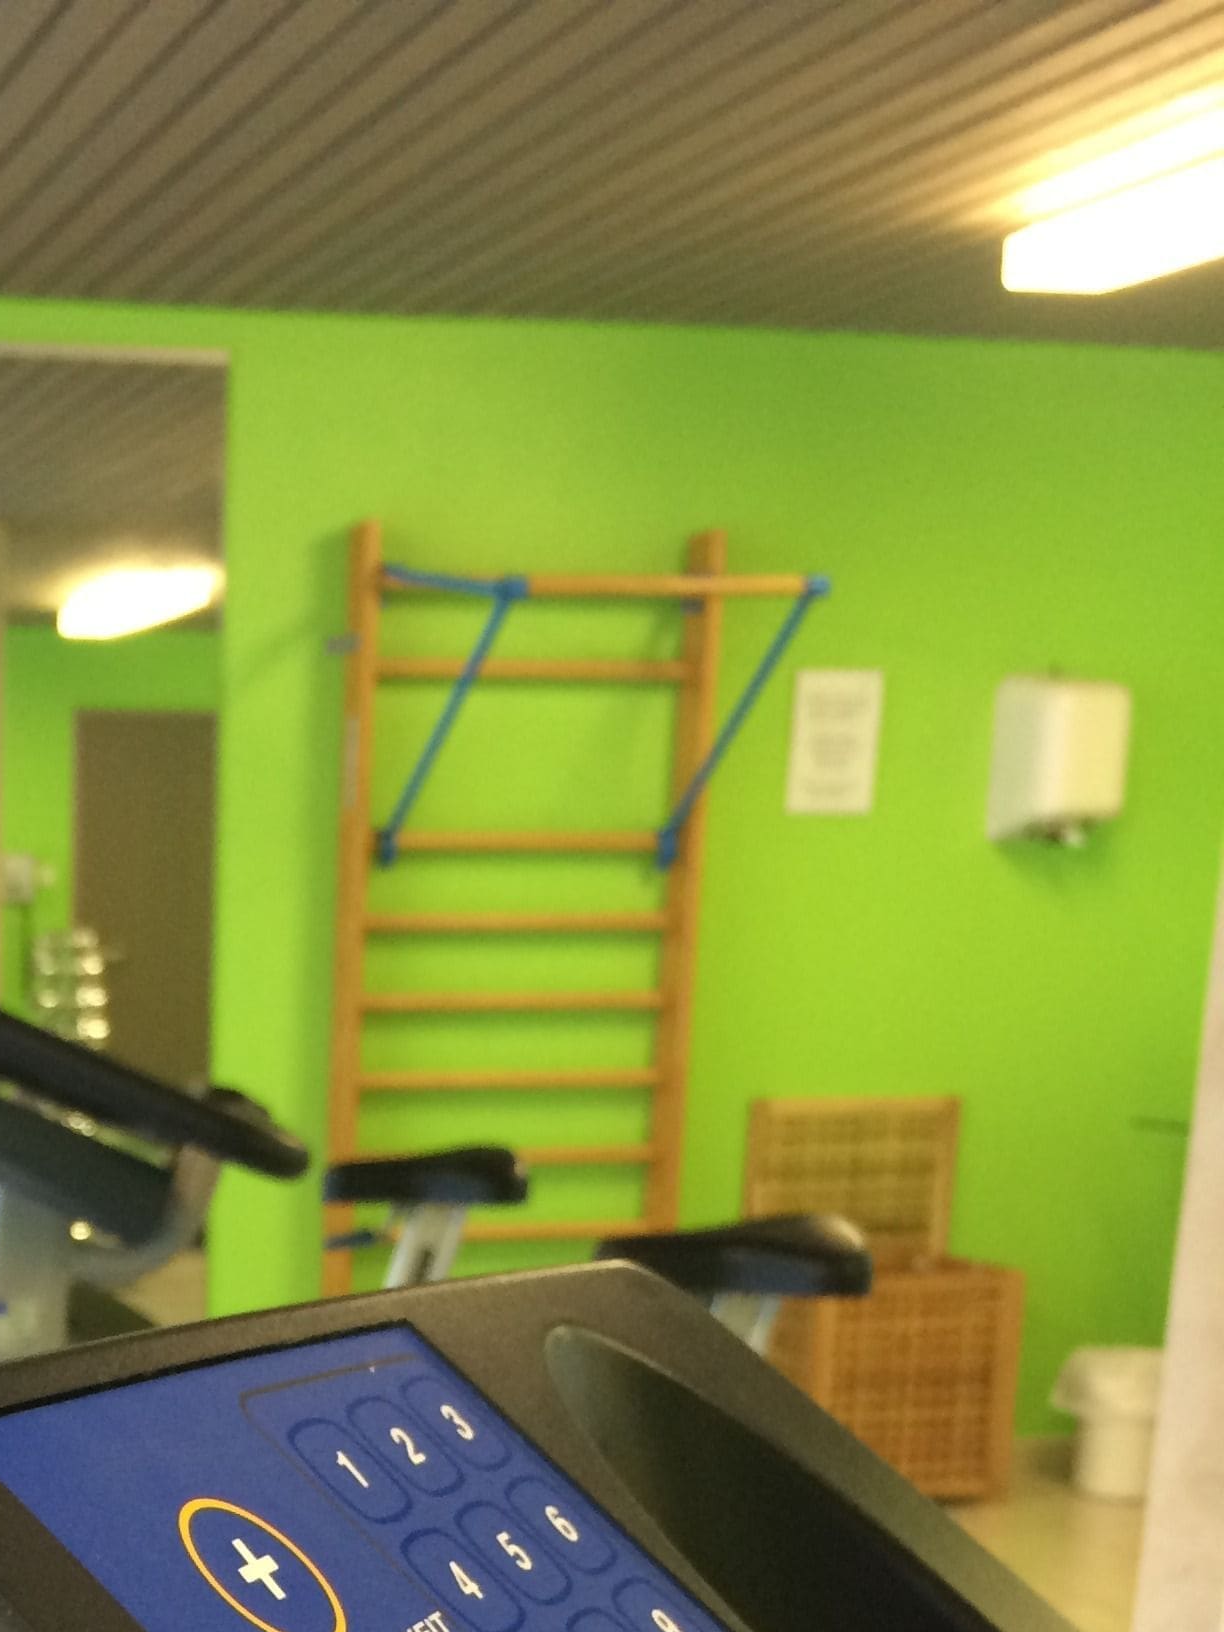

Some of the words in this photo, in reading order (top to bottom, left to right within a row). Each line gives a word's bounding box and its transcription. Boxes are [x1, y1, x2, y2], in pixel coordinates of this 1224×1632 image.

[440, 1404, 474, 1441] 3
[390, 1427, 427, 1466] 2
[336, 1450, 369, 1489] 1
[544, 1505, 579, 1542] 6
[496, 1531, 533, 1571] 5
[449, 1561, 485, 1600] 4
